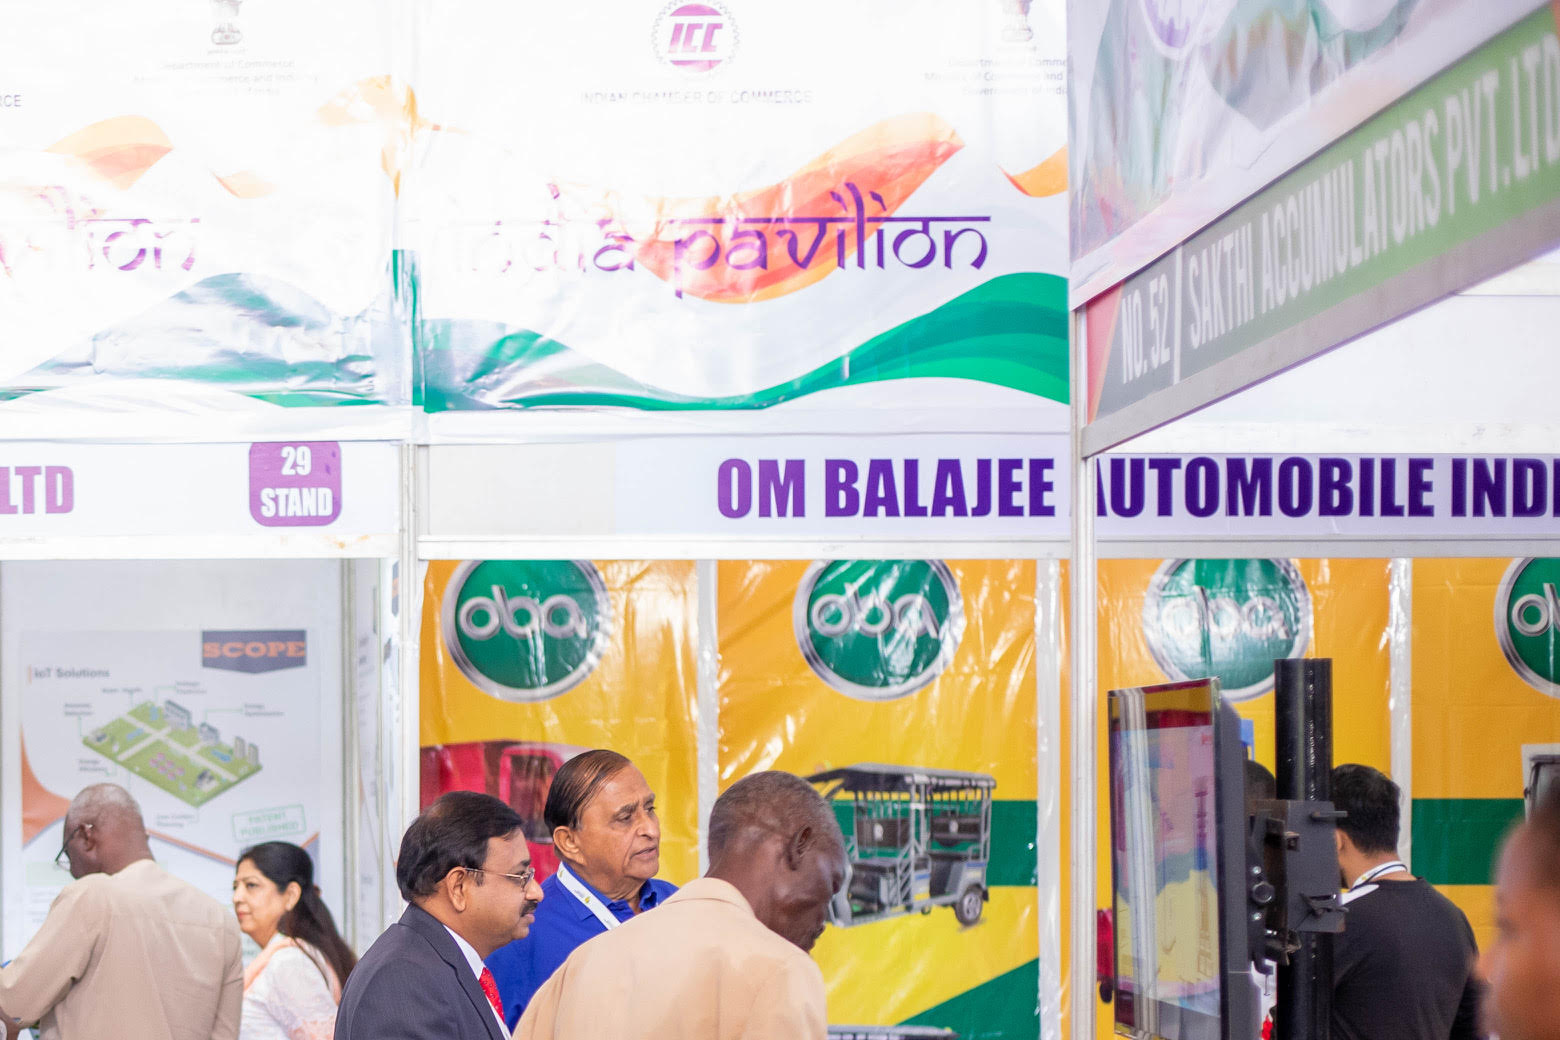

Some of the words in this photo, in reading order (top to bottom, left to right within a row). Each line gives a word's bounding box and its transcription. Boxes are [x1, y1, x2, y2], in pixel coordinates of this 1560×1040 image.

[668, 23, 723, 53] ICC
[1149, 271, 1171, 369] 52
[1188, 222, 1255, 350] SAKTHI
[1260, 108, 1441, 315] ACCUMULATORS
[280, 446, 313, 476] 29
[259, 487, 334, 518] STAND
[716, 458, 807, 519] OM
[824, 458, 1056, 519] BALAJEE
[458, 586, 588, 640] oba
[811, 583, 940, 640] oba
[202, 641, 307, 659] SCOPE
[56, 666, 111, 678] Solutions
